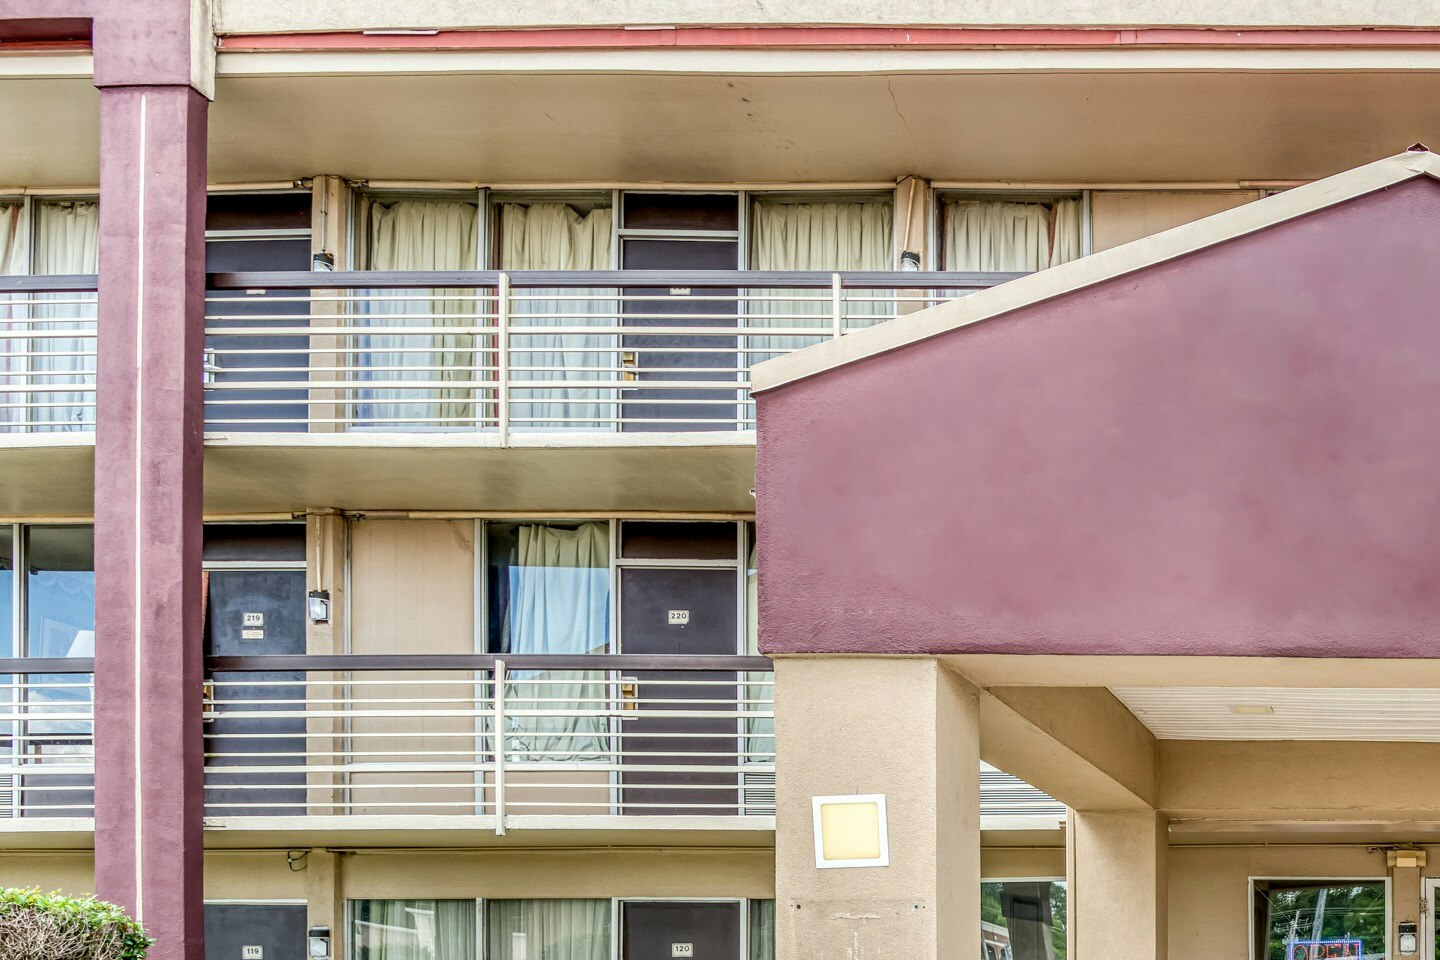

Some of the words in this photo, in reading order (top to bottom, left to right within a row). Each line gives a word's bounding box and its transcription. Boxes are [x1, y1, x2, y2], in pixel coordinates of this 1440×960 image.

[246, 614, 261, 622] 219
[670, 612, 687, 620] 220
[246, 947, 260, 955] 119
